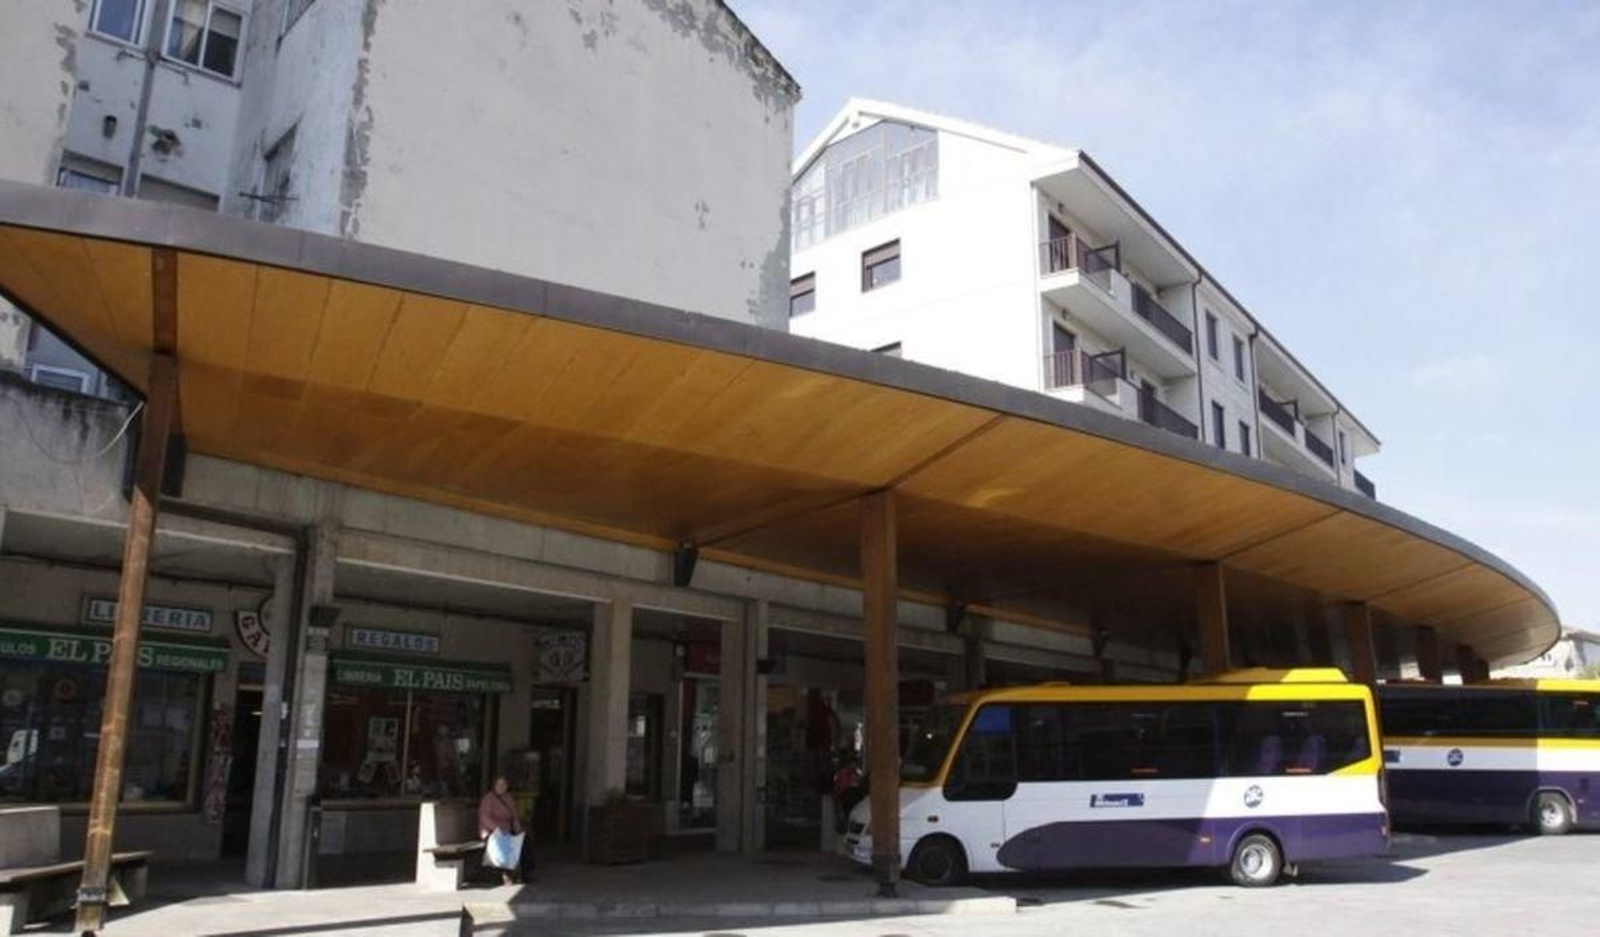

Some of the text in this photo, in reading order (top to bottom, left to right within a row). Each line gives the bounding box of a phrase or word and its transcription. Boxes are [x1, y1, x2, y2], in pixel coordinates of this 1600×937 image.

[93, 601, 206, 628] LIERIA
[356, 631, 436, 650] REGALOS
[46, 638, 87, 660] EL
[91, 641, 153, 667] PS
[394, 669, 421, 687] EL
